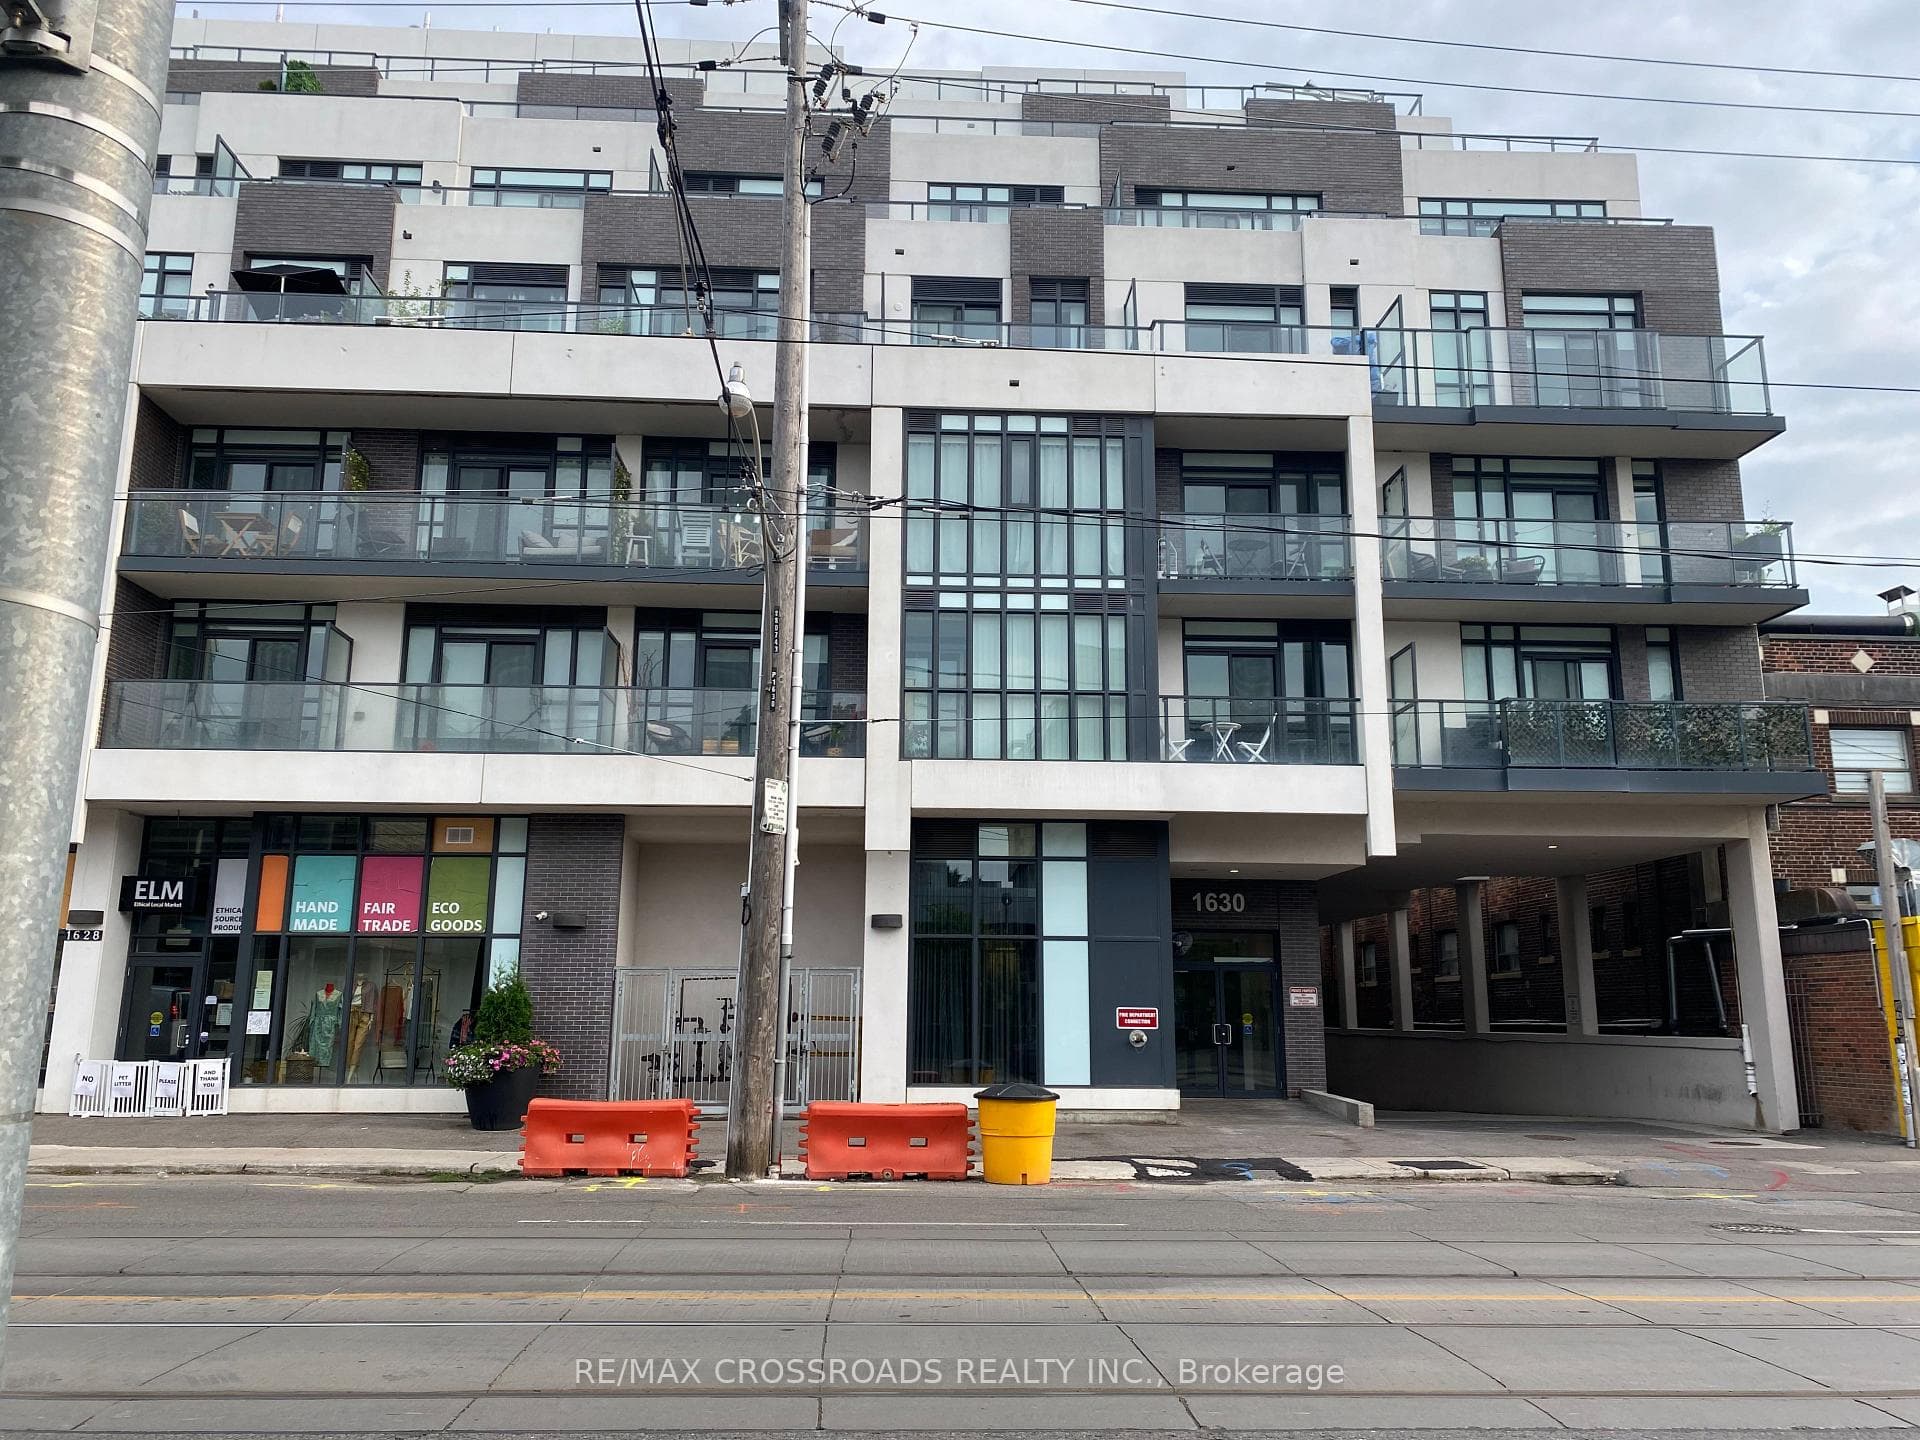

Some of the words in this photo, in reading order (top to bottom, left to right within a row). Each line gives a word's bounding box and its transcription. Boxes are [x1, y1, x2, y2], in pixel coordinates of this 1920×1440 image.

[134, 880, 184, 900] ELM
[295, 901, 339, 913] HAND
[363, 902, 396, 914] FAIR
[432, 902, 460, 914] ECO
[1192, 892, 1245, 912] 1630
[293, 918, 337, 931] MADE
[362, 919, 411, 932] TRADE
[430, 919, 482, 932] GOODS
[66, 930, 101, 941] 1628
[81, 1075, 94, 1083] NO
